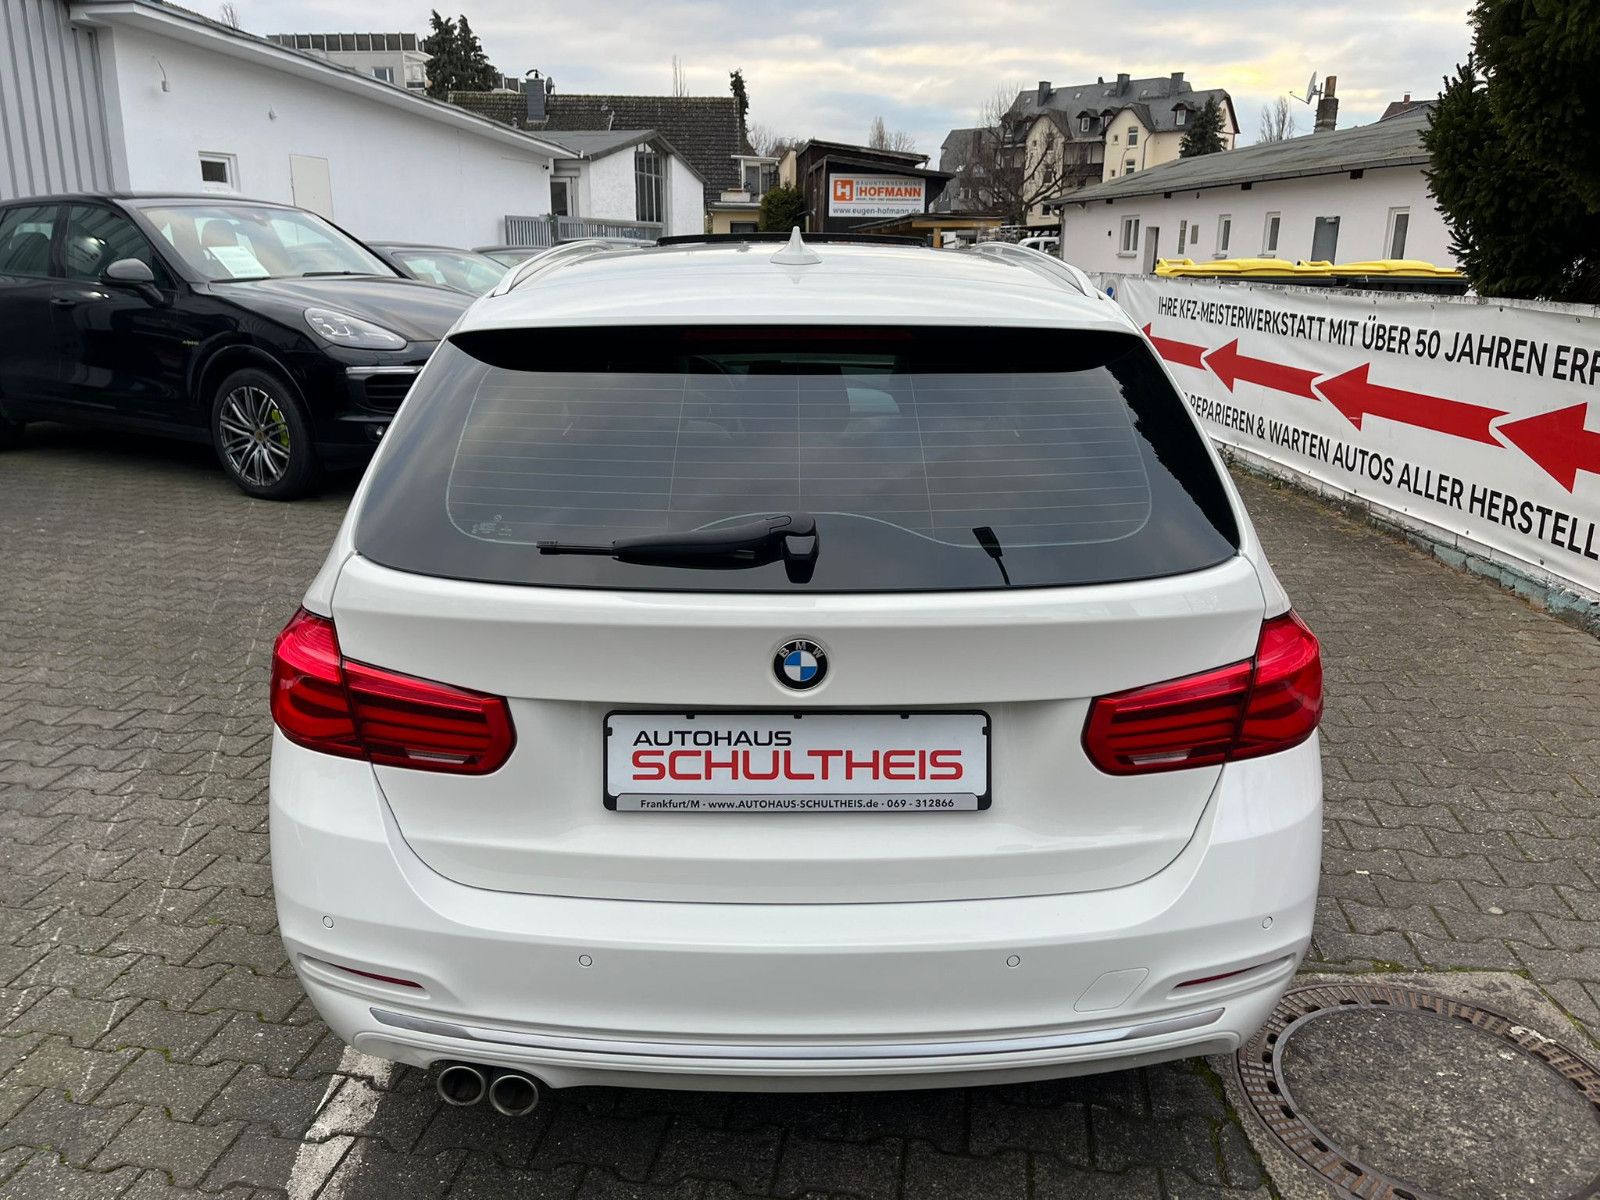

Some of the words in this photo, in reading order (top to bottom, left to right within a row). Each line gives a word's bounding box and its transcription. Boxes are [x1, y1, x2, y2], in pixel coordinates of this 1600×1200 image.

[859, 187, 921, 197] HOFMANN
[833, 207, 921, 215] www.eugen-hofmann.de
[1158, 296, 1178, 317] IHRE
[1178, 299, 1326, 342] KFZ-MEISTERWERKSTATT
[1328, 318, 1359, 347] MIT
[1361, 315, 1411, 355] ÜBER
[1415, 329, 1441, 360] 50
[1444, 331, 1548, 377] JAHREN
[1256, 416, 1266, 440] &
[1269, 419, 1330, 463] WARTEN
[1332, 441, 1394, 485] AUTOS
[1397, 463, 1463, 510] ALLER
[1468, 483, 1600, 561] HERSTELL
[779, 640, 824, 660] BMW
[632, 730, 792, 747] AUTOHAUS
[632, 750, 964, 781] SCHULTHEIS
[640, 799, 700, 809] Frankfurt/M
[708, 799, 879, 809] www.AUTOHAUS-SCHULTHEIS.de
[887, 799, 906, 808] 069
[915, 799, 954, 808] 312866
